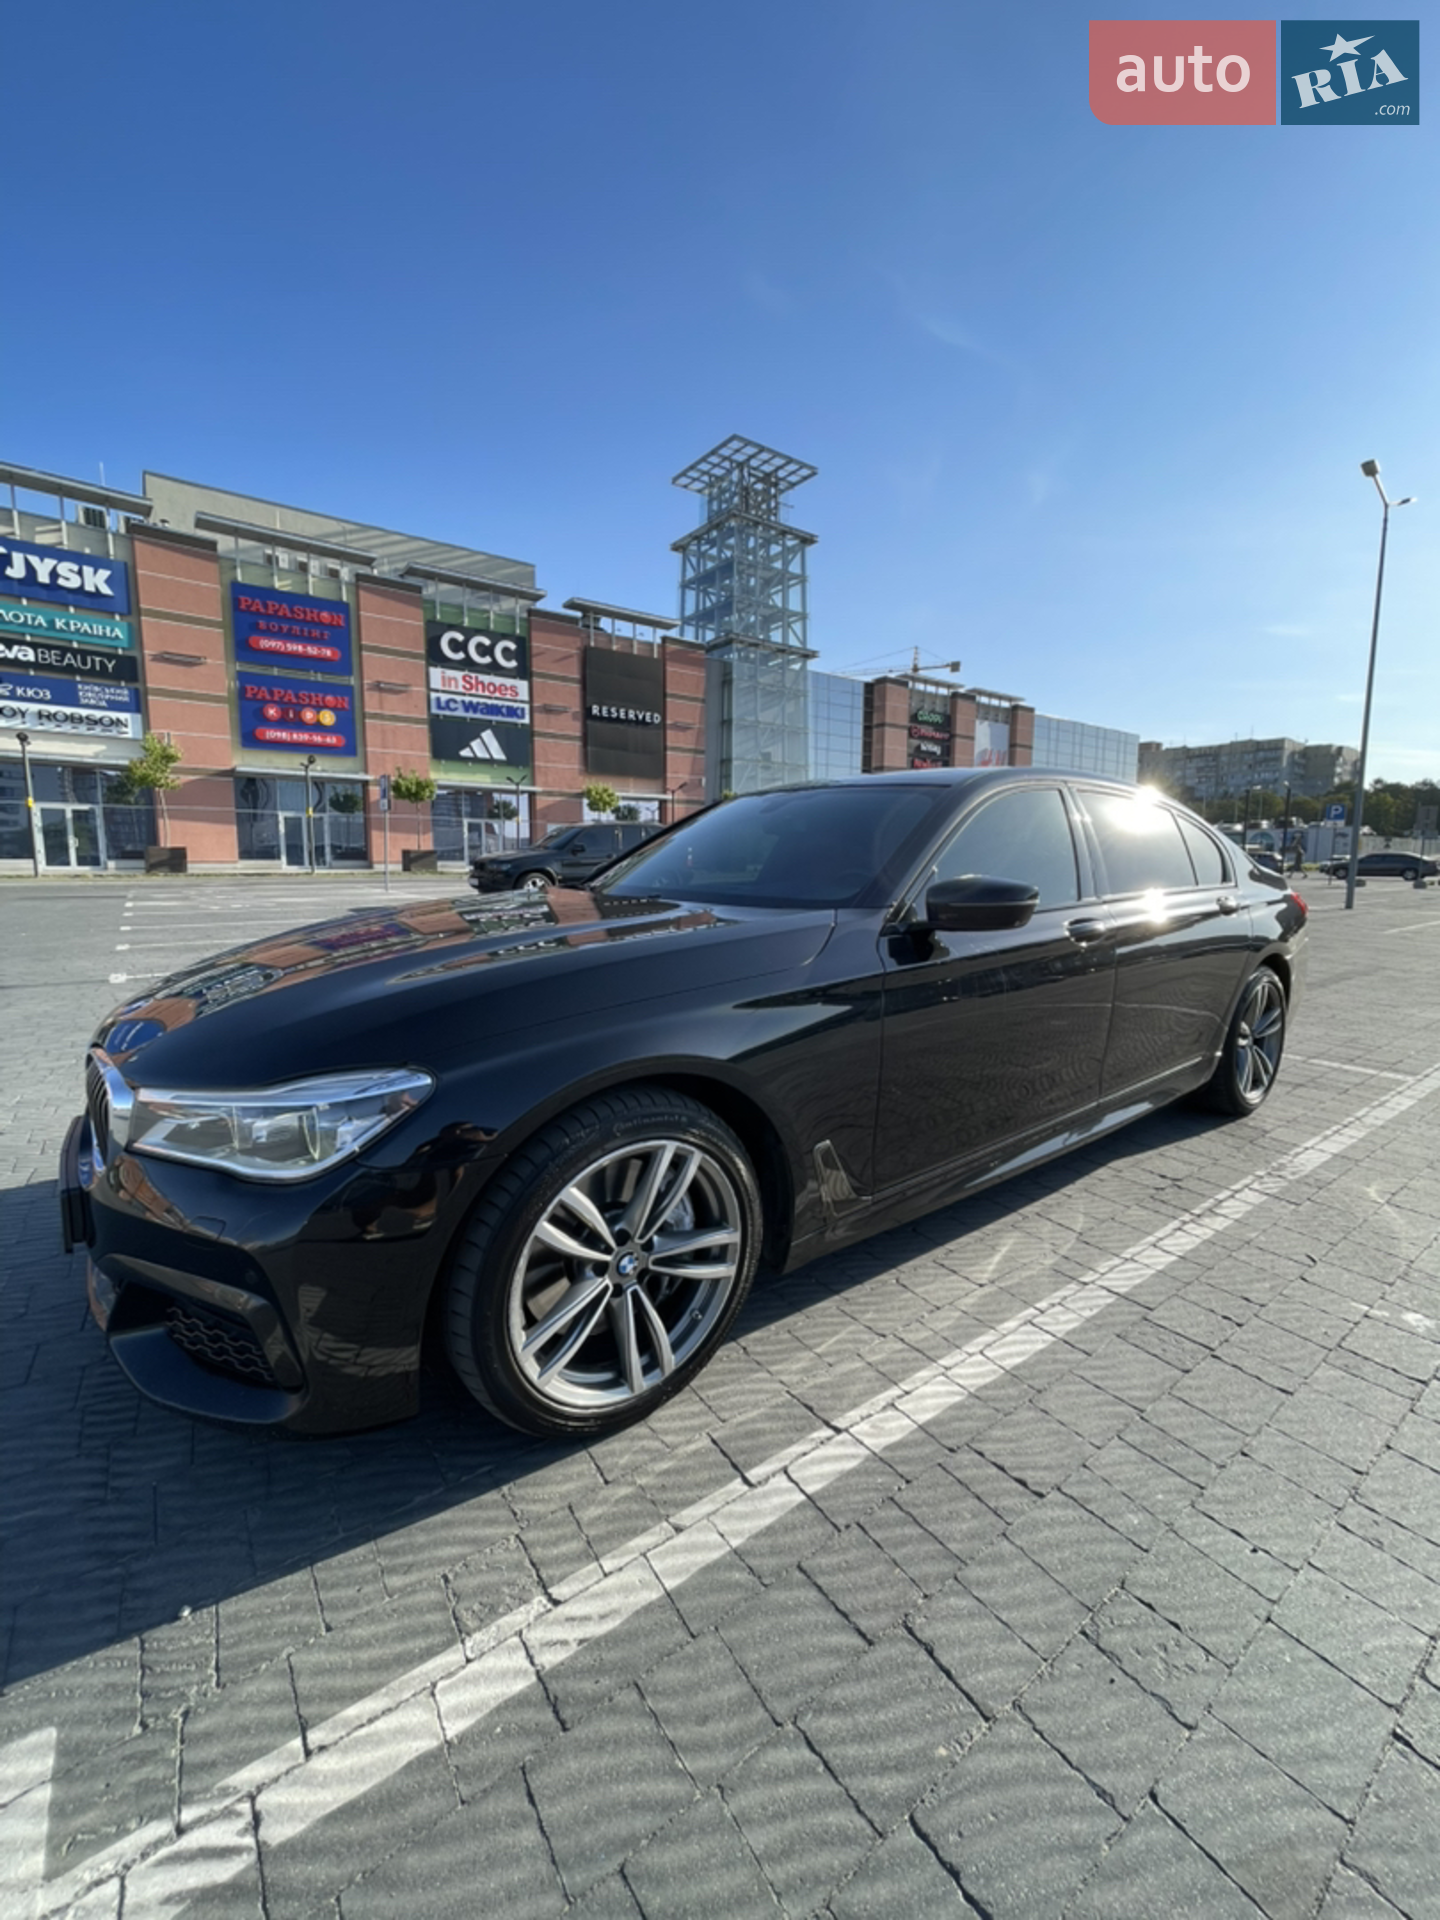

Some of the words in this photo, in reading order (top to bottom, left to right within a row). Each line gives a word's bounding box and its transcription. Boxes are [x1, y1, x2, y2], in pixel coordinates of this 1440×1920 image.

[4, 551, 115, 597] JYSK
[238, 596, 346, 627] PAPASHON
[37, 648, 116, 673] BEAUTY
[440, 630, 518, 669] CCC
[16, 686, 52, 701] КЮЗ
[441, 670, 459, 690] in
[461, 674, 519, 698] Shoes
[245, 684, 350, 712] PAPASHON
[435, 696, 459, 712] LC
[38, 708, 130, 729] ROBSON
[591, 704, 662, 724] RESERVED
[1329, 804, 1343, 819] P
